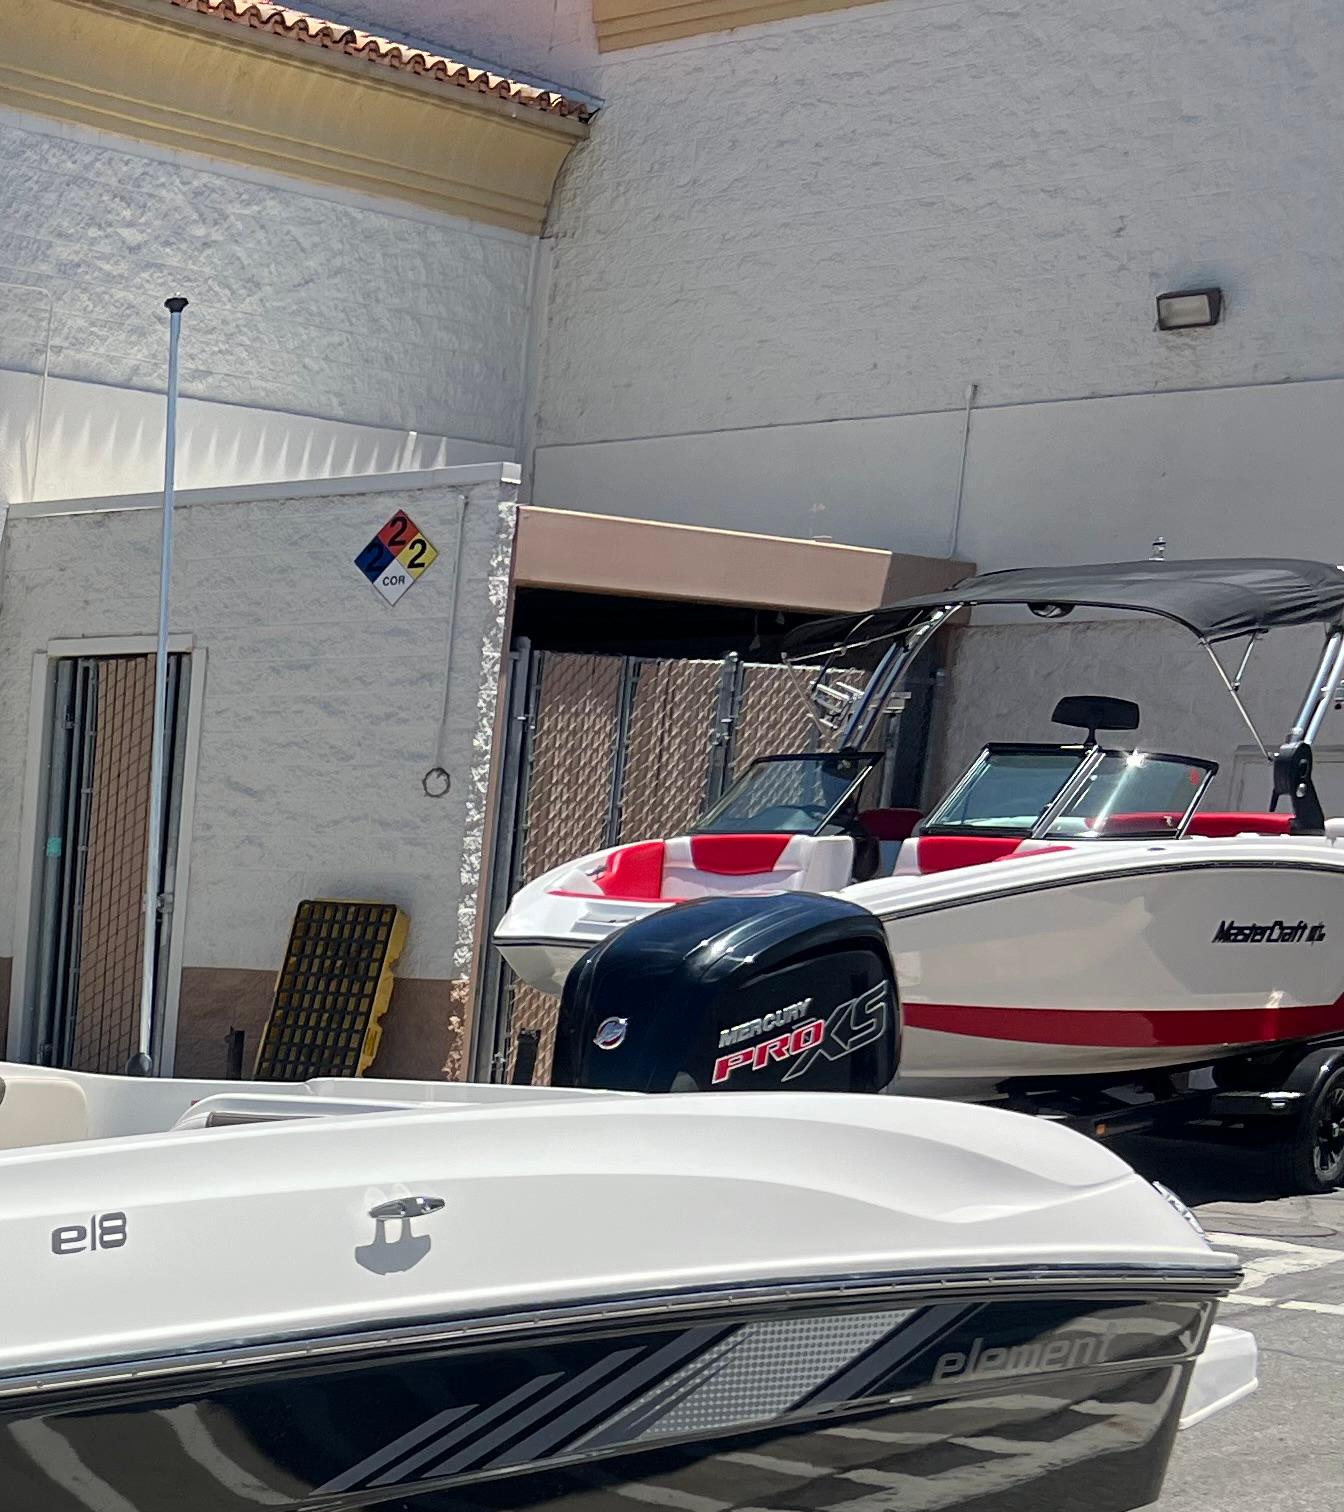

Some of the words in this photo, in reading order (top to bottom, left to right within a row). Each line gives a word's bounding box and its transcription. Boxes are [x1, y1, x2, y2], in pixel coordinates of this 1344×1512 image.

[388, 516, 408, 547] 2
[367, 542, 385, 572] 2
[407, 538, 427, 569] 2
[382, 575, 405, 587] COR
[718, 998, 814, 1048] MERCURY
[712, 1019, 827, 1085] PRO
[931, 1322, 1118, 1385] element
